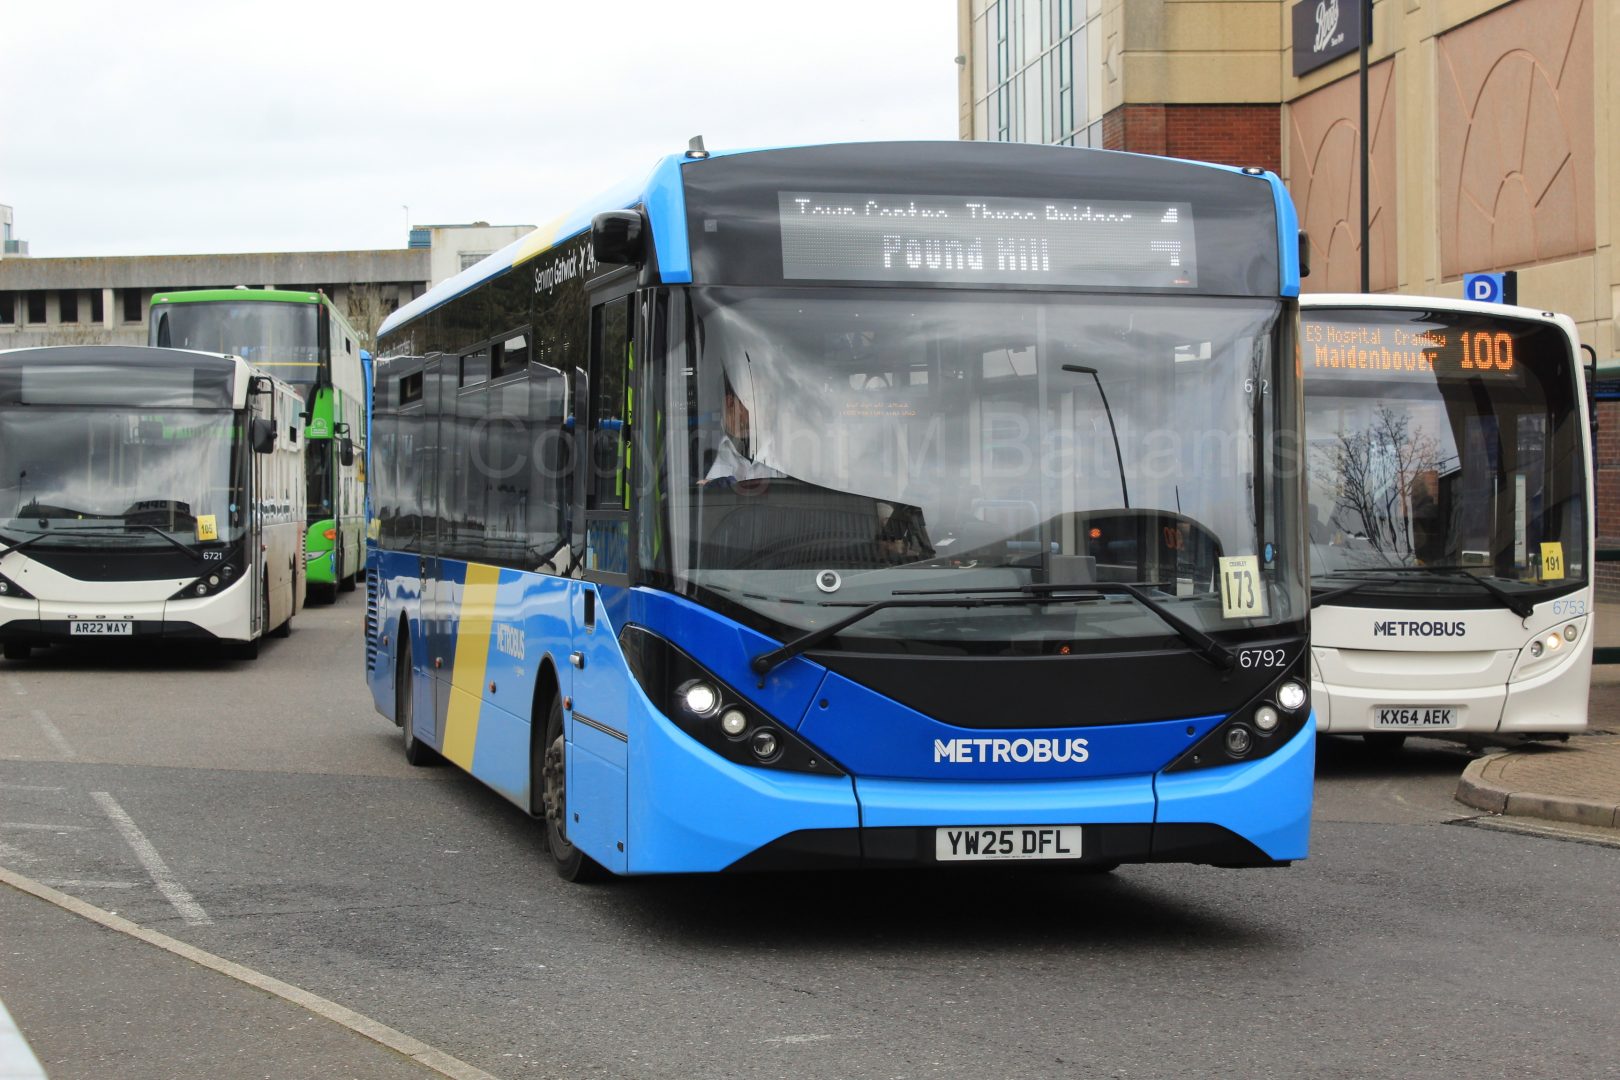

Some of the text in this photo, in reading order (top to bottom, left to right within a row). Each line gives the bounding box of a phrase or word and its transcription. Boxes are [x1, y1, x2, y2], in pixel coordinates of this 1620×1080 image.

[882, 234, 1049, 271] Pound Hill
[534, 261, 554, 295] Serving
[554, 249, 577, 285] Gatwick
[1474, 281, 1492, 300] D
[1327, 325, 1381, 345] Hospital
[1315, 344, 1438, 372] Maidenbower
[1459, 330, 1514, 371] 100
[203, 551, 223, 560] 6721
[1545, 555, 1560, 572] 191
[1225, 570, 1255, 610] 173
[1552, 600, 1586, 615] 6753
[75, 622, 128, 633] AR22 WAY
[1373, 620, 1466, 637] METROBUS
[1240, 649, 1286, 668] 6792
[1380, 708, 1451, 725] KX64 AEK
[934, 738, 1089, 763] METROBUS
[947, 830, 1071, 855] YW25 DFL
